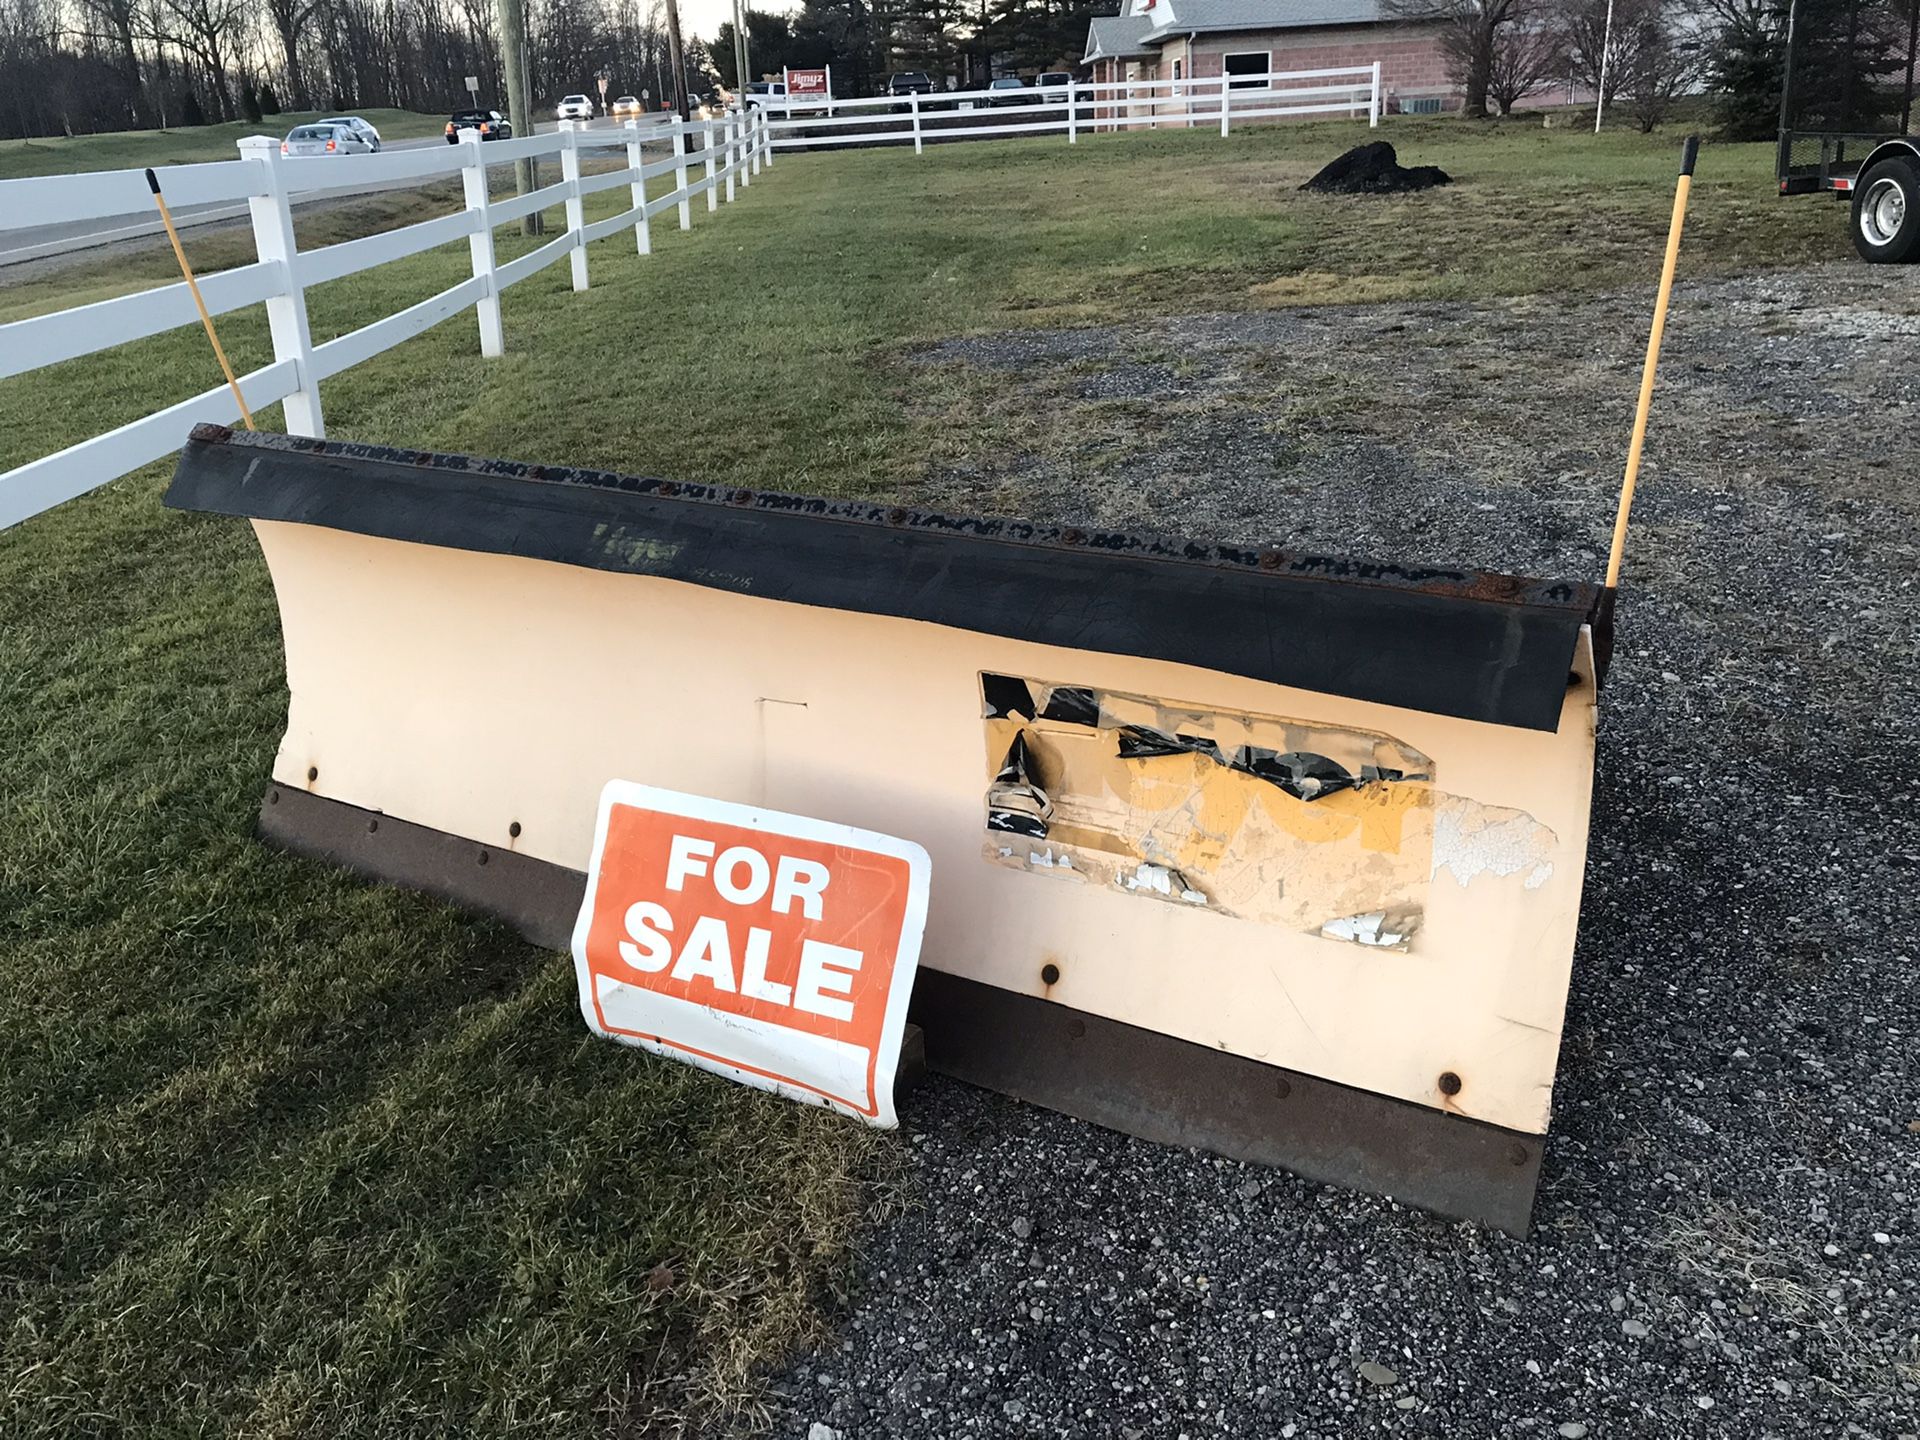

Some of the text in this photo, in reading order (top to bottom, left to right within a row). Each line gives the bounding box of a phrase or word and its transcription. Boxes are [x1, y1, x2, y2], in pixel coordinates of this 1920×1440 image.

[791, 73, 824, 89] Jimyz
[665, 834, 830, 921] FOR
[618, 901, 864, 1022] SALE
